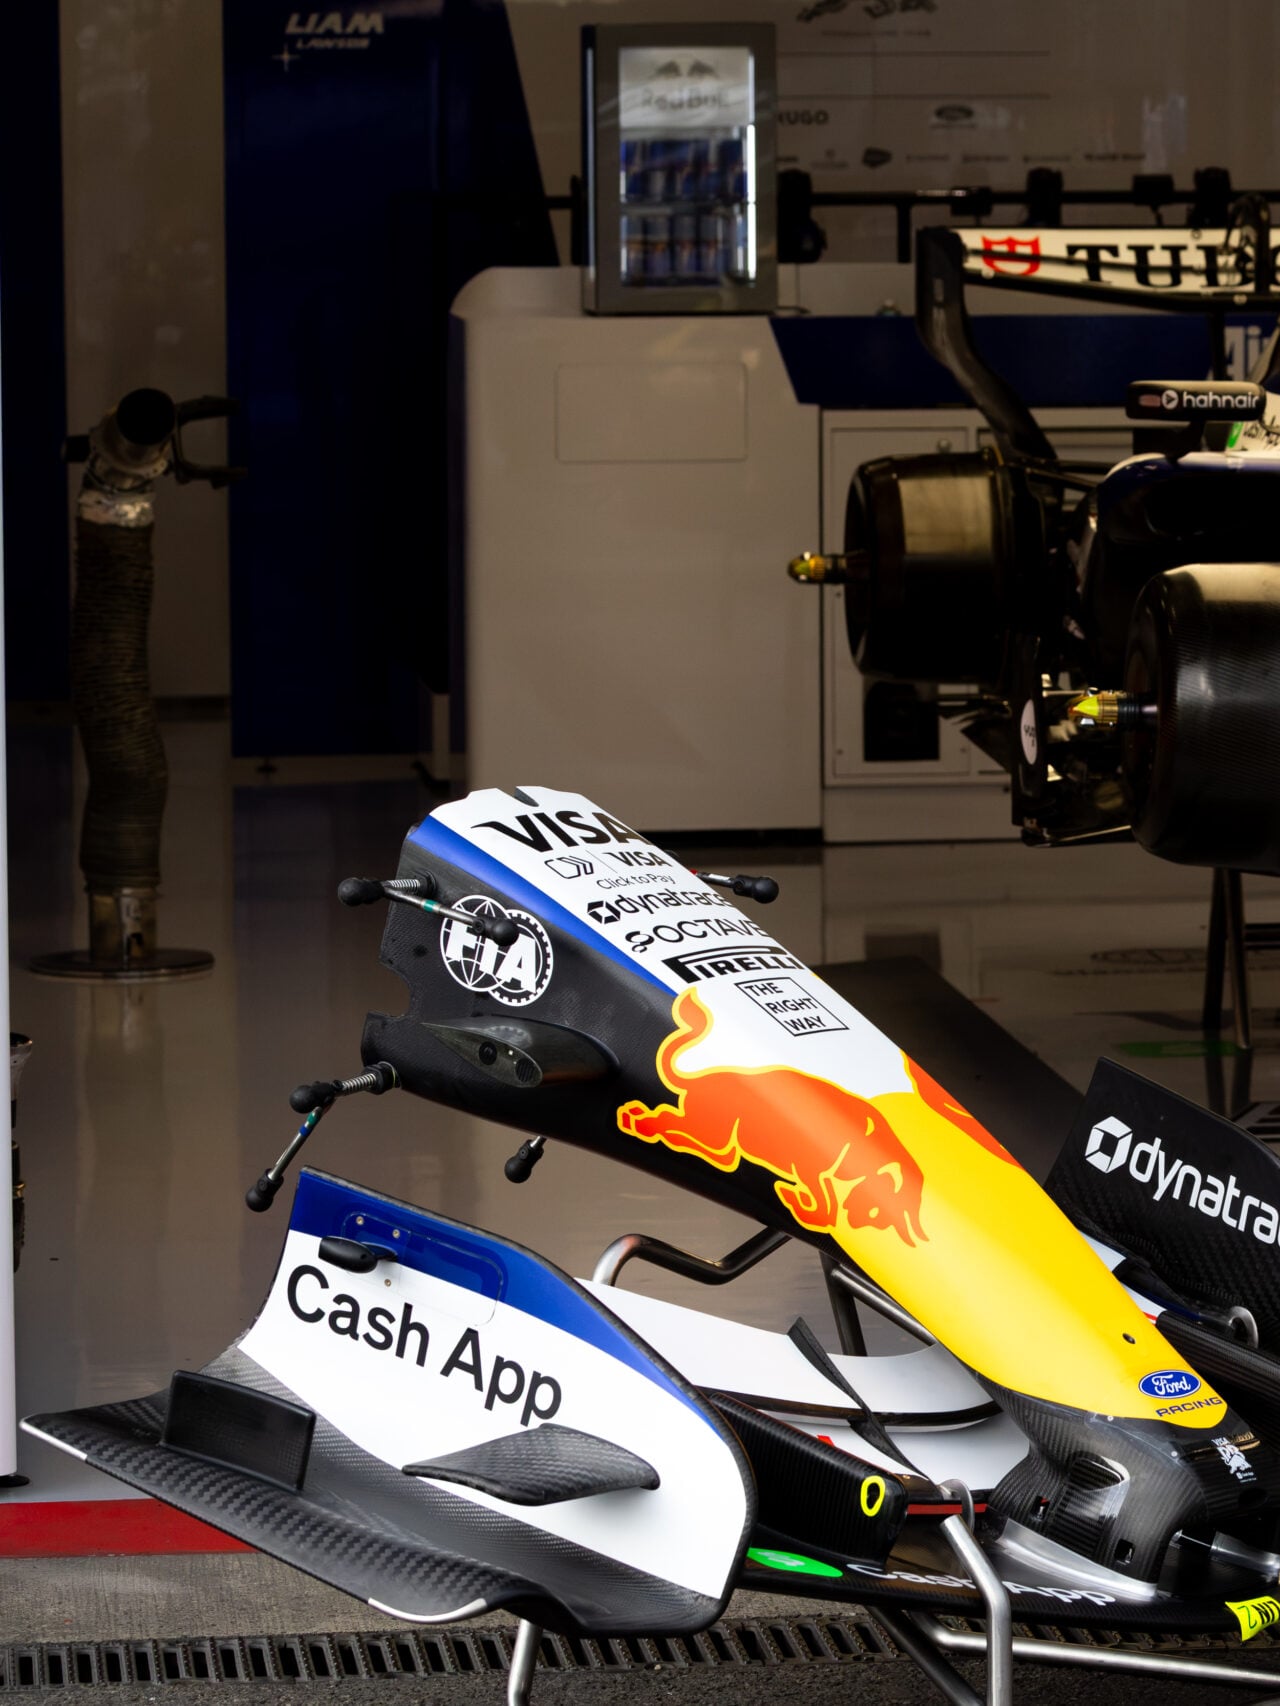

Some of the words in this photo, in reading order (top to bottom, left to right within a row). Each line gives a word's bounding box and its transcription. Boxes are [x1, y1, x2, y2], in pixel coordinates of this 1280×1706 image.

[284, 12, 386, 36] LIAM
[1182, 390, 1259, 410] hahnair
[471, 810, 656, 853] VISA
[602, 851, 673, 867] VISA
[596, 876, 634, 890] Click
[636, 877, 649, 885] to
[650, 872, 676, 887] Pay
[617, 888, 735, 915] dynatrace
[652, 917, 768, 944] OCTAVE
[446, 915, 537, 994] FIA
[661, 946, 805, 984] PIRELLI
[744, 981, 784, 998] THE
[765, 997, 818, 1015] RIGHT
[783, 1015, 827, 1032] WAY
[287, 1265, 430, 1367] Cash
[440, 1327, 563, 1427] App
[1151, 1374, 1191, 1395] Ford
[1156, 1396, 1222, 1416] RACING
[1001, 1580, 1116, 1607] App
